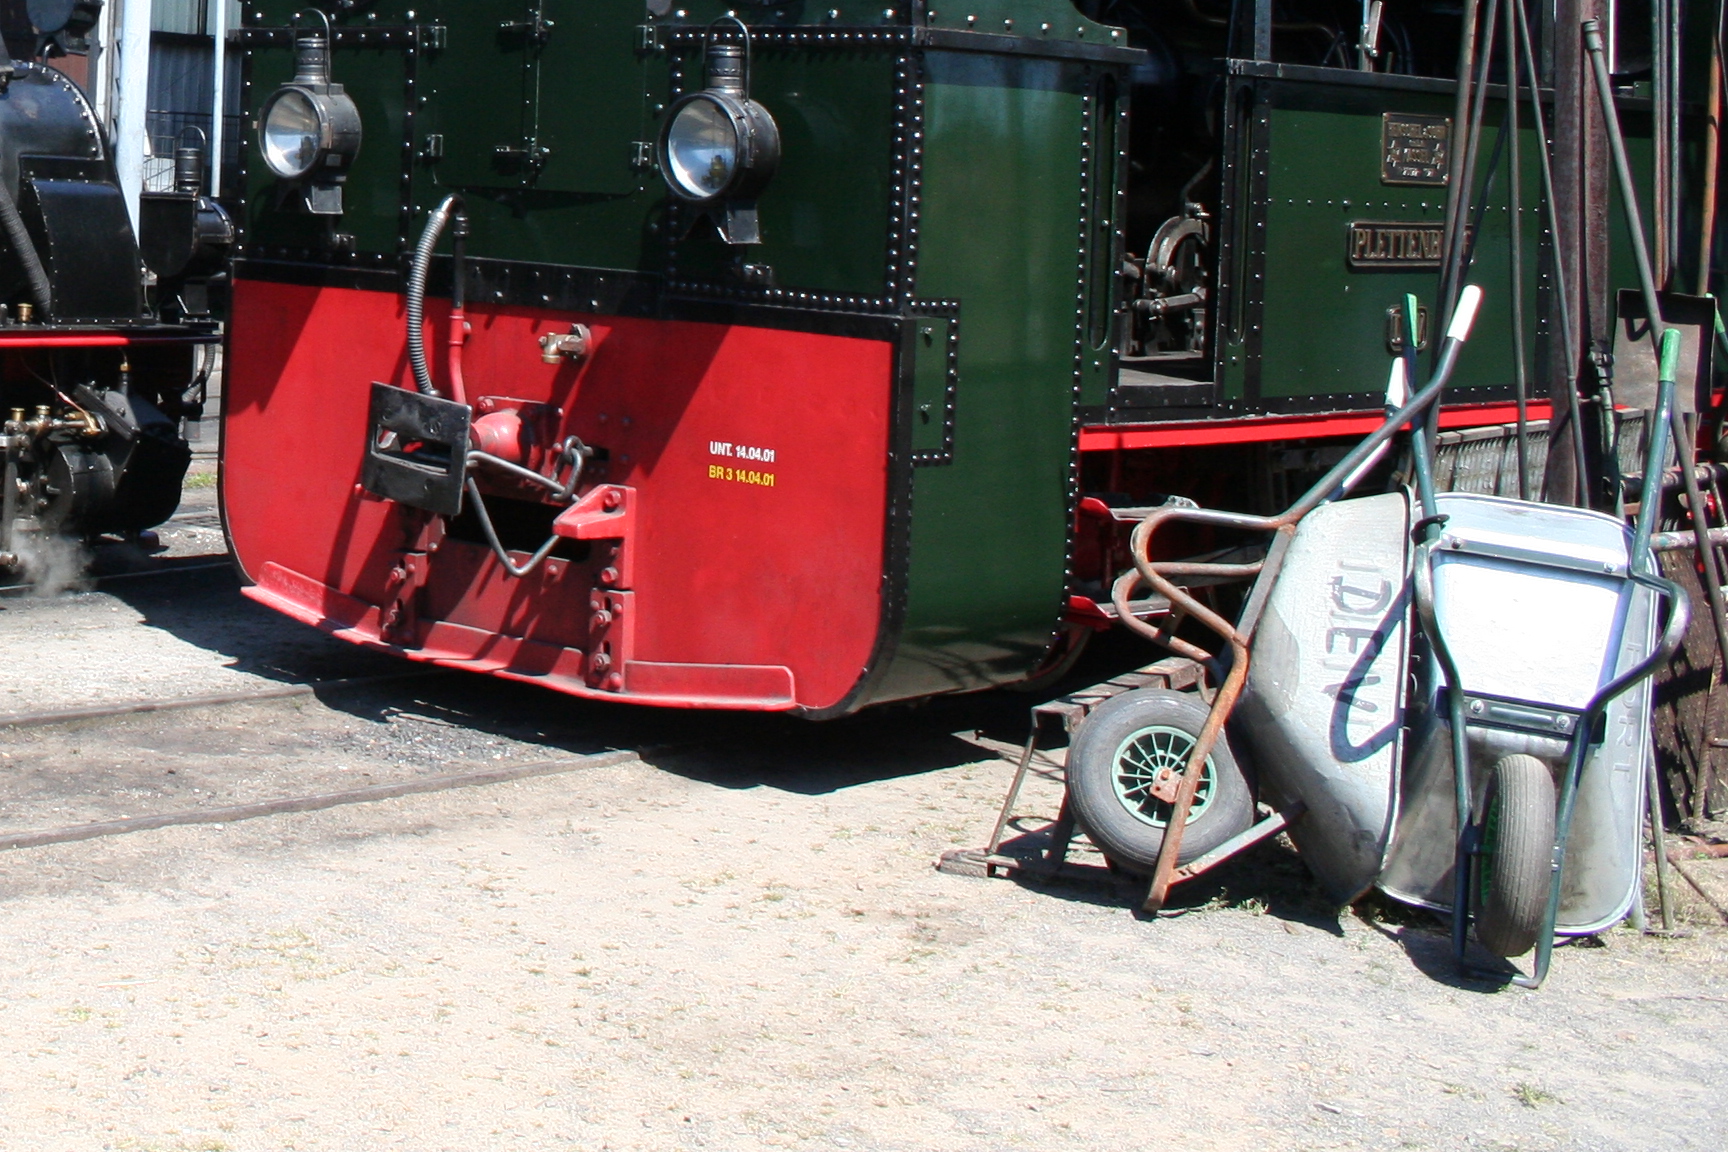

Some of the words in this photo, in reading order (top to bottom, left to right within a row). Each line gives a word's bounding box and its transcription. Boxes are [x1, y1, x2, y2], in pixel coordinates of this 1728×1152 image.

[735, 444, 775, 462] 14.04.01
[708, 464, 724, 480] BR
[725, 467, 733, 481] 3
[735, 469, 775, 487] 14.04.01
[1322, 575, 1392, 713] DEV
